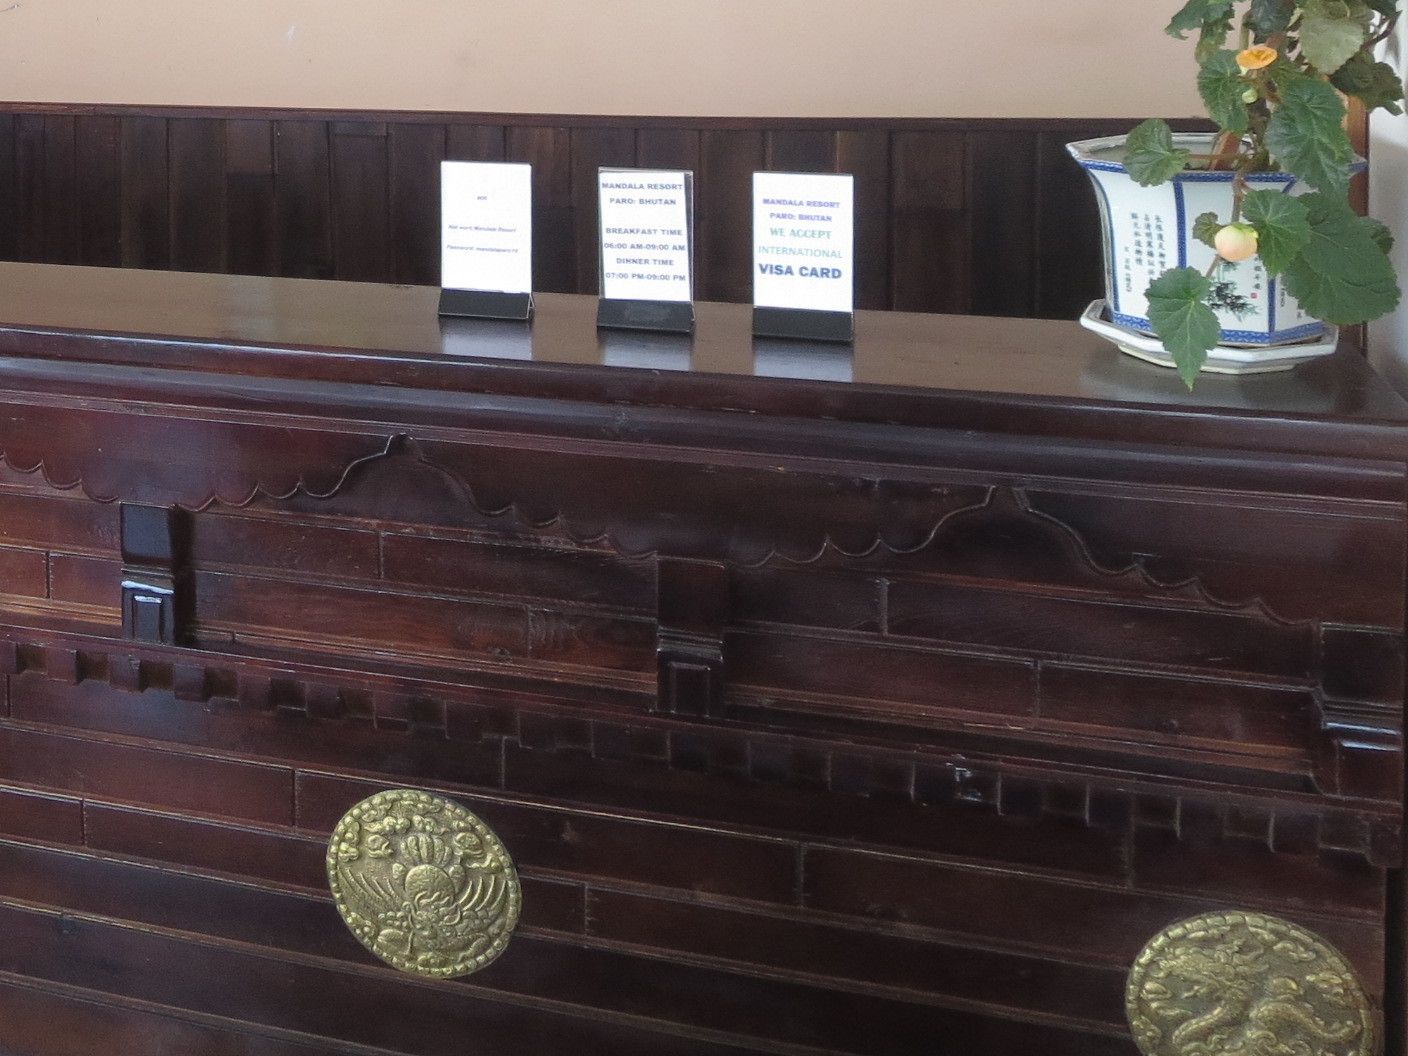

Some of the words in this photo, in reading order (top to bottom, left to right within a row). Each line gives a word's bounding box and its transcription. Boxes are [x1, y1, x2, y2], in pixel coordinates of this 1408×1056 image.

[762, 198, 805, 207] MANDALA
[806, 200, 841, 208] RESORT
[798, 213, 833, 222] BHUTAN
[605, 227, 658, 235] BREAKFAST
[770, 228, 786, 237] WE
[789, 228, 833, 239] ACCEPT
[758, 245, 844, 259] INTERNATIONAL
[758, 263, 795, 276] VISA
[798, 265, 843, 279] CARD
